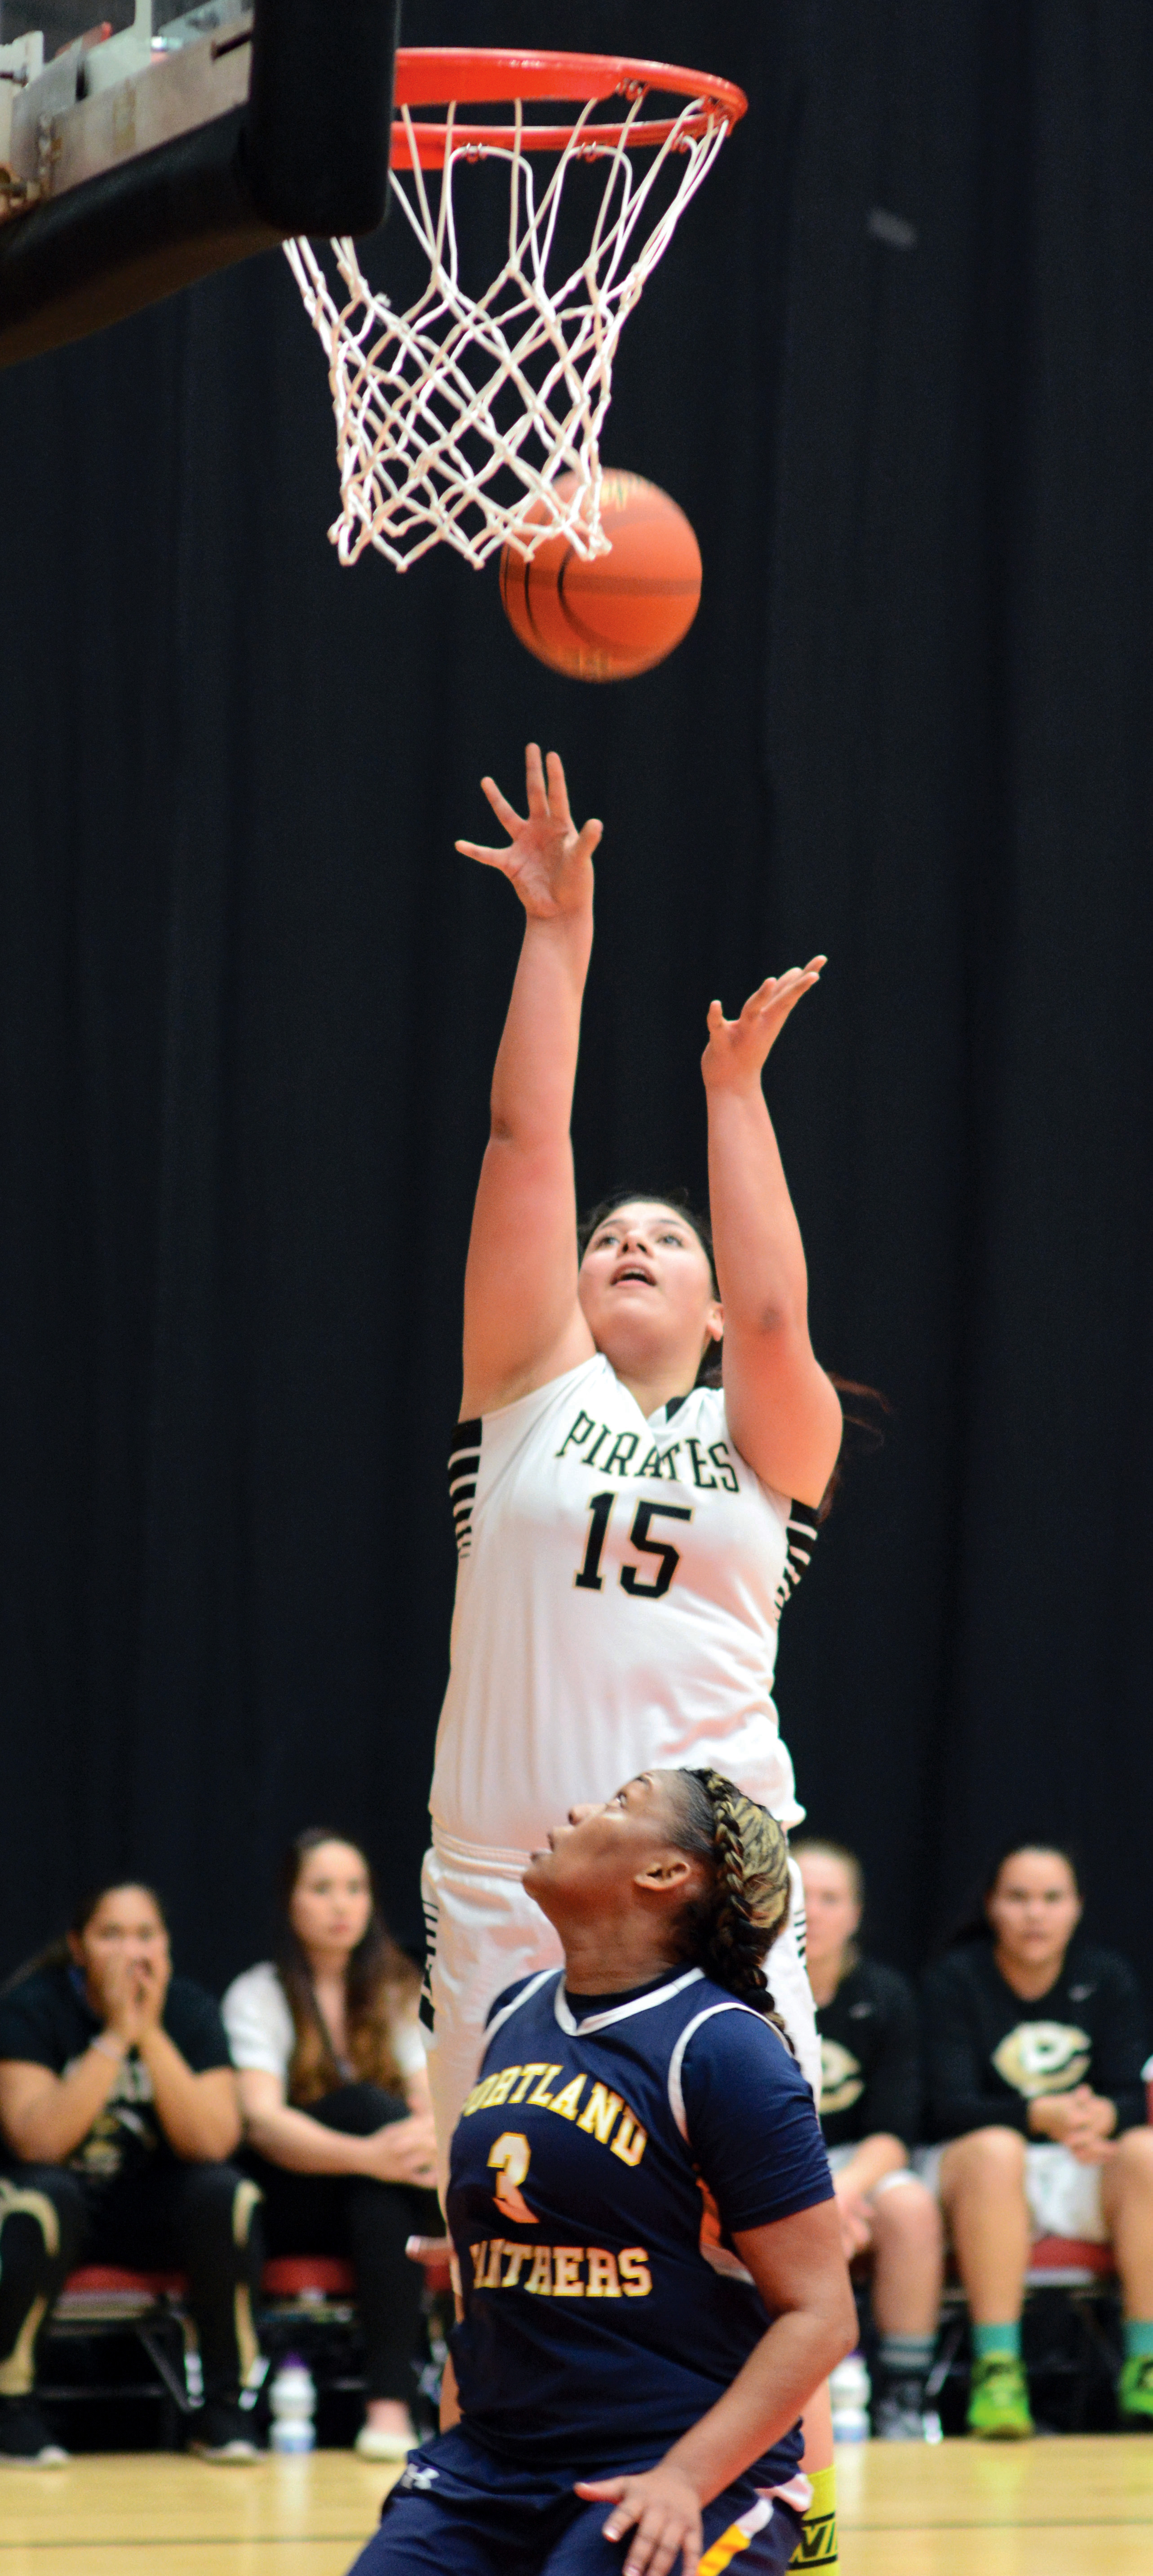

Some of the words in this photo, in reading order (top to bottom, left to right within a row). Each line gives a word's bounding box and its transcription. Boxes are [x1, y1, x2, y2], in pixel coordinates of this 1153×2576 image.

[554, 1410, 740, 1493] PIRATES
[573, 1490, 696, 1601] 15
[461, 2062, 648, 2167] ORTLAND
[487, 2132, 540, 2224] 3
